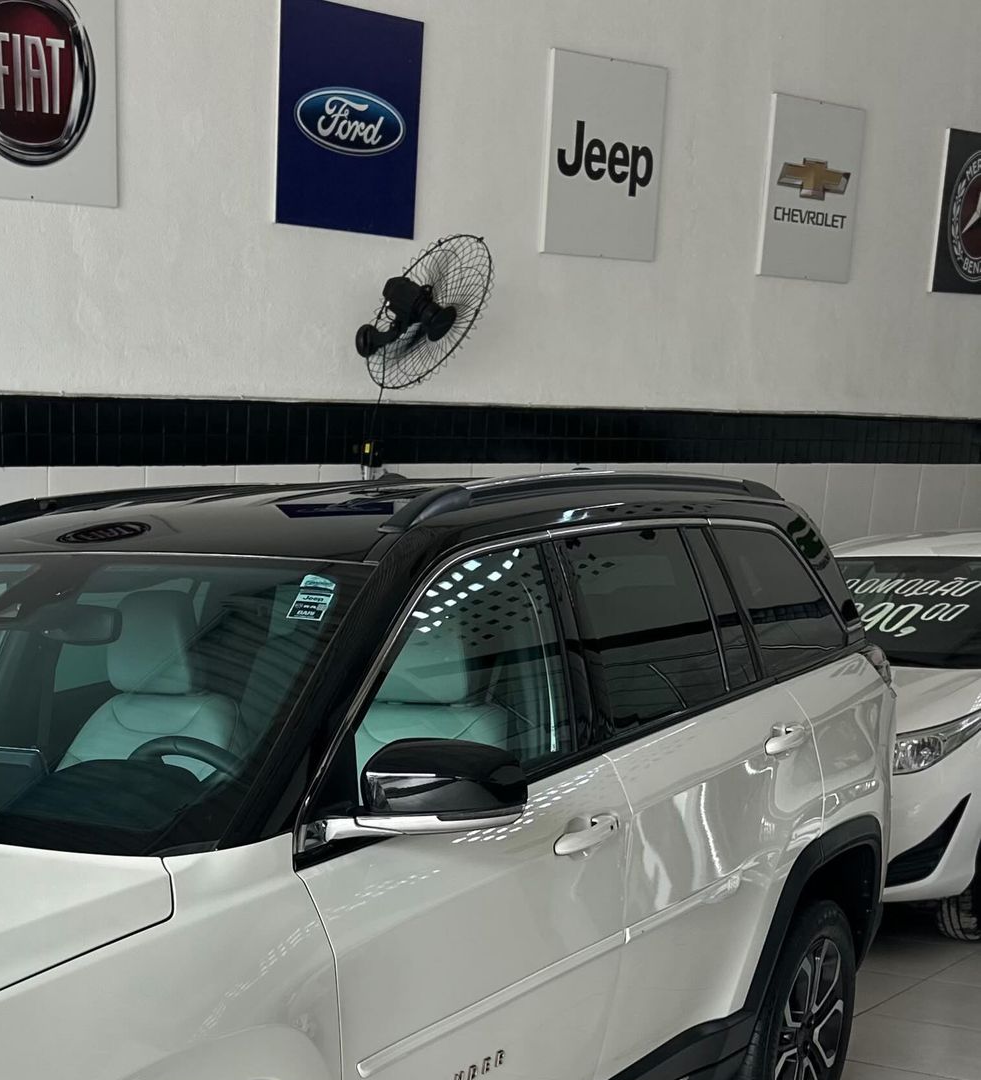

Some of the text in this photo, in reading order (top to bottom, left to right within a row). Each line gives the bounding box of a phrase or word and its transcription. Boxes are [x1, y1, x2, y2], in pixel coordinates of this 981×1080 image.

[317, 95, 385, 148] Ford
[556, 120, 654, 197] Jeep
[773, 206, 847, 229] CHEVROLET
